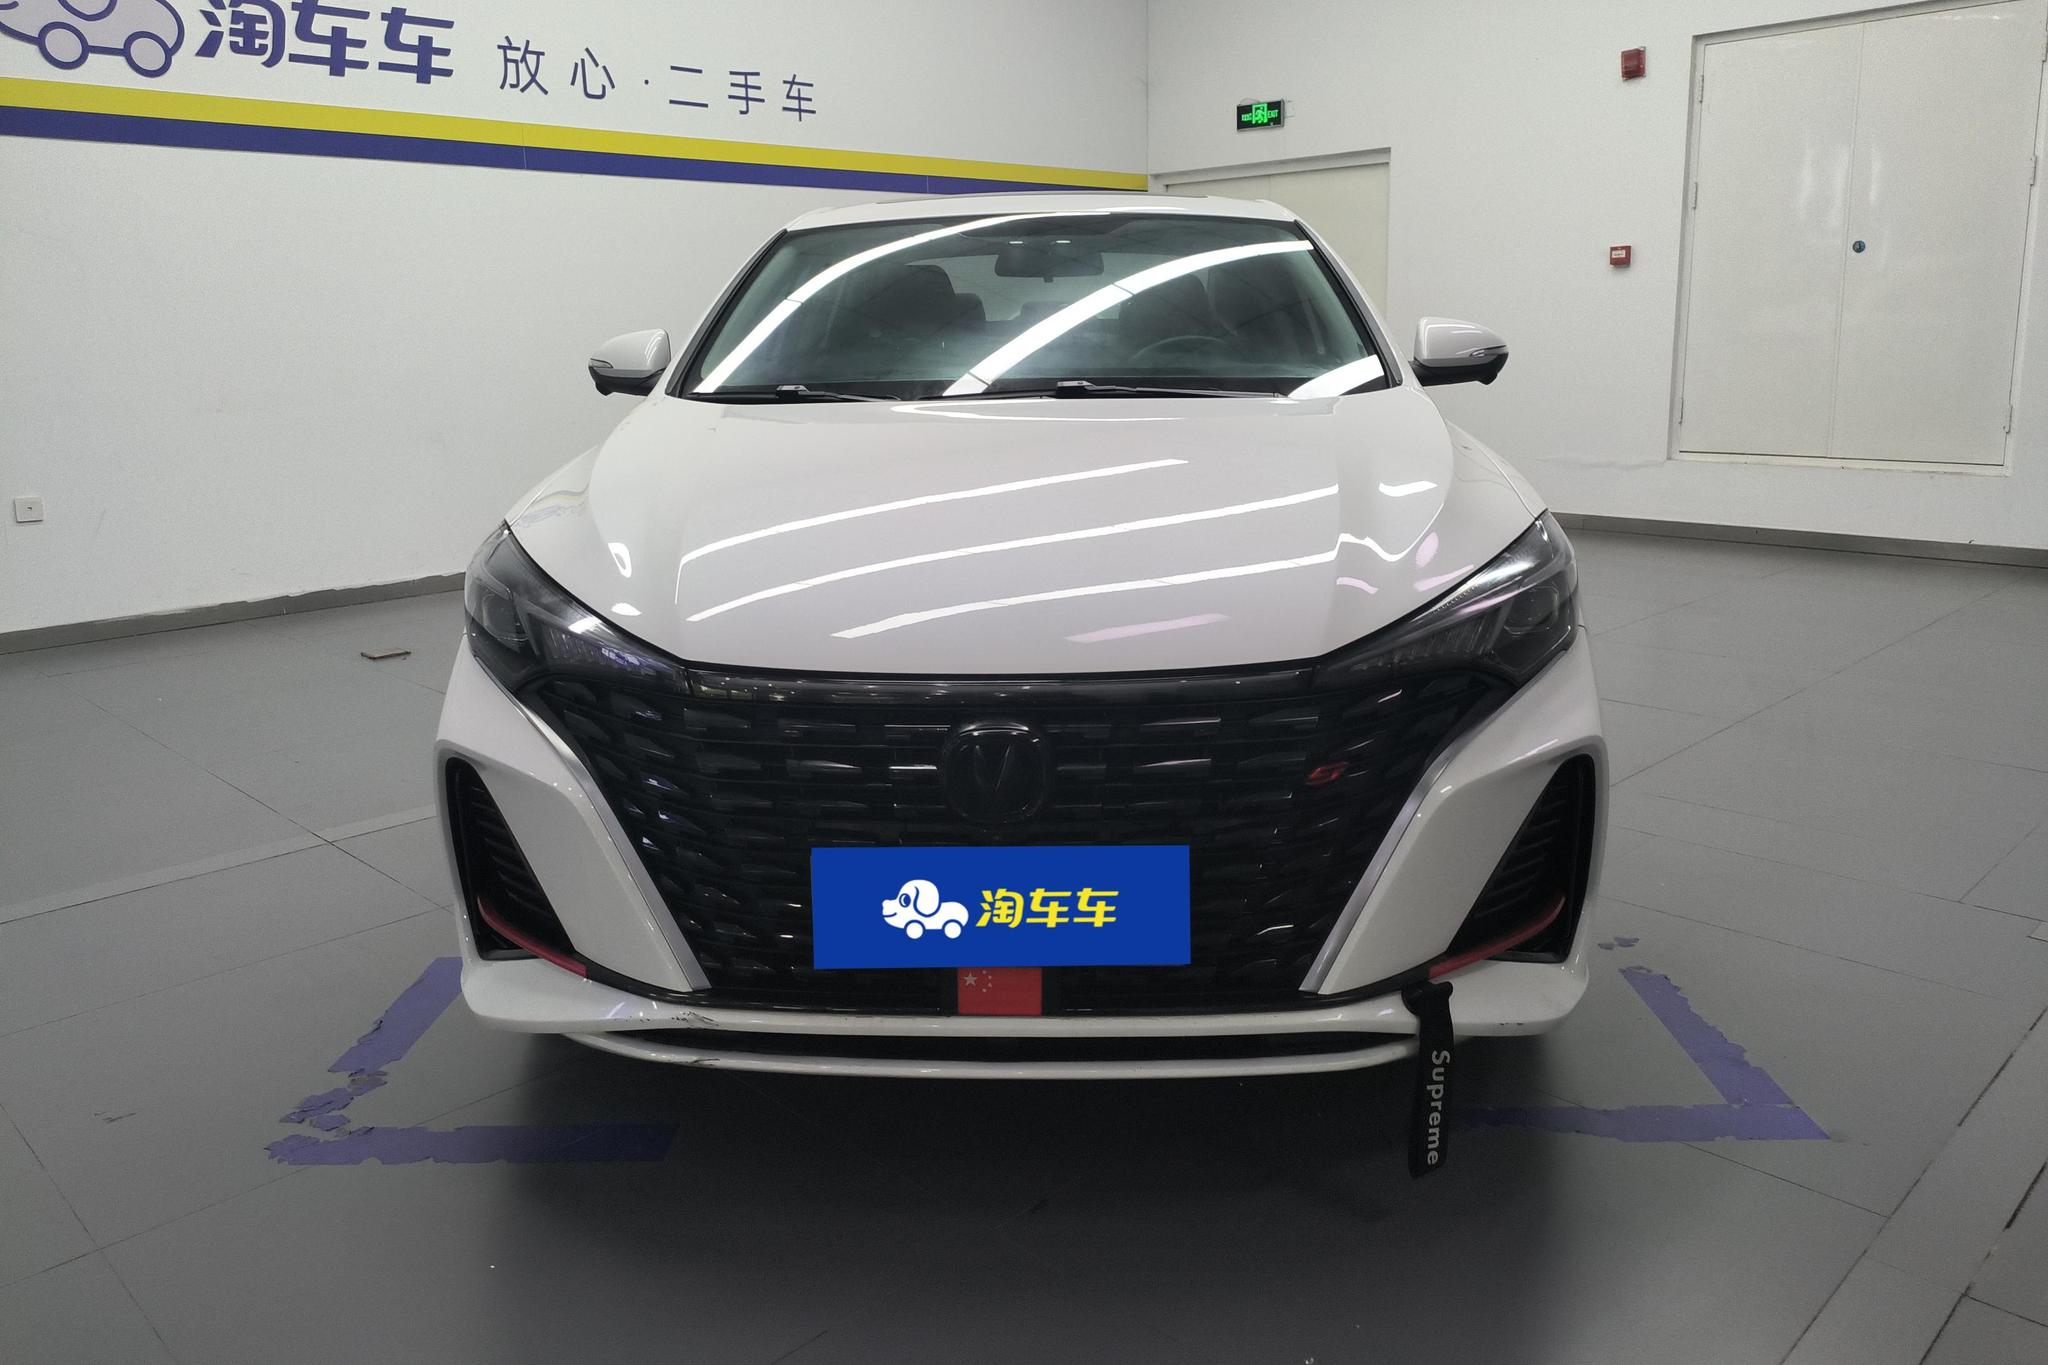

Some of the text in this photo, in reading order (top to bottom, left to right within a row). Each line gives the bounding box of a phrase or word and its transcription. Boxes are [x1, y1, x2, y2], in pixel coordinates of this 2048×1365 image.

[195, 0, 454, 84] 淘车车
[1427, 1050, 1450, 1165] Supreme
